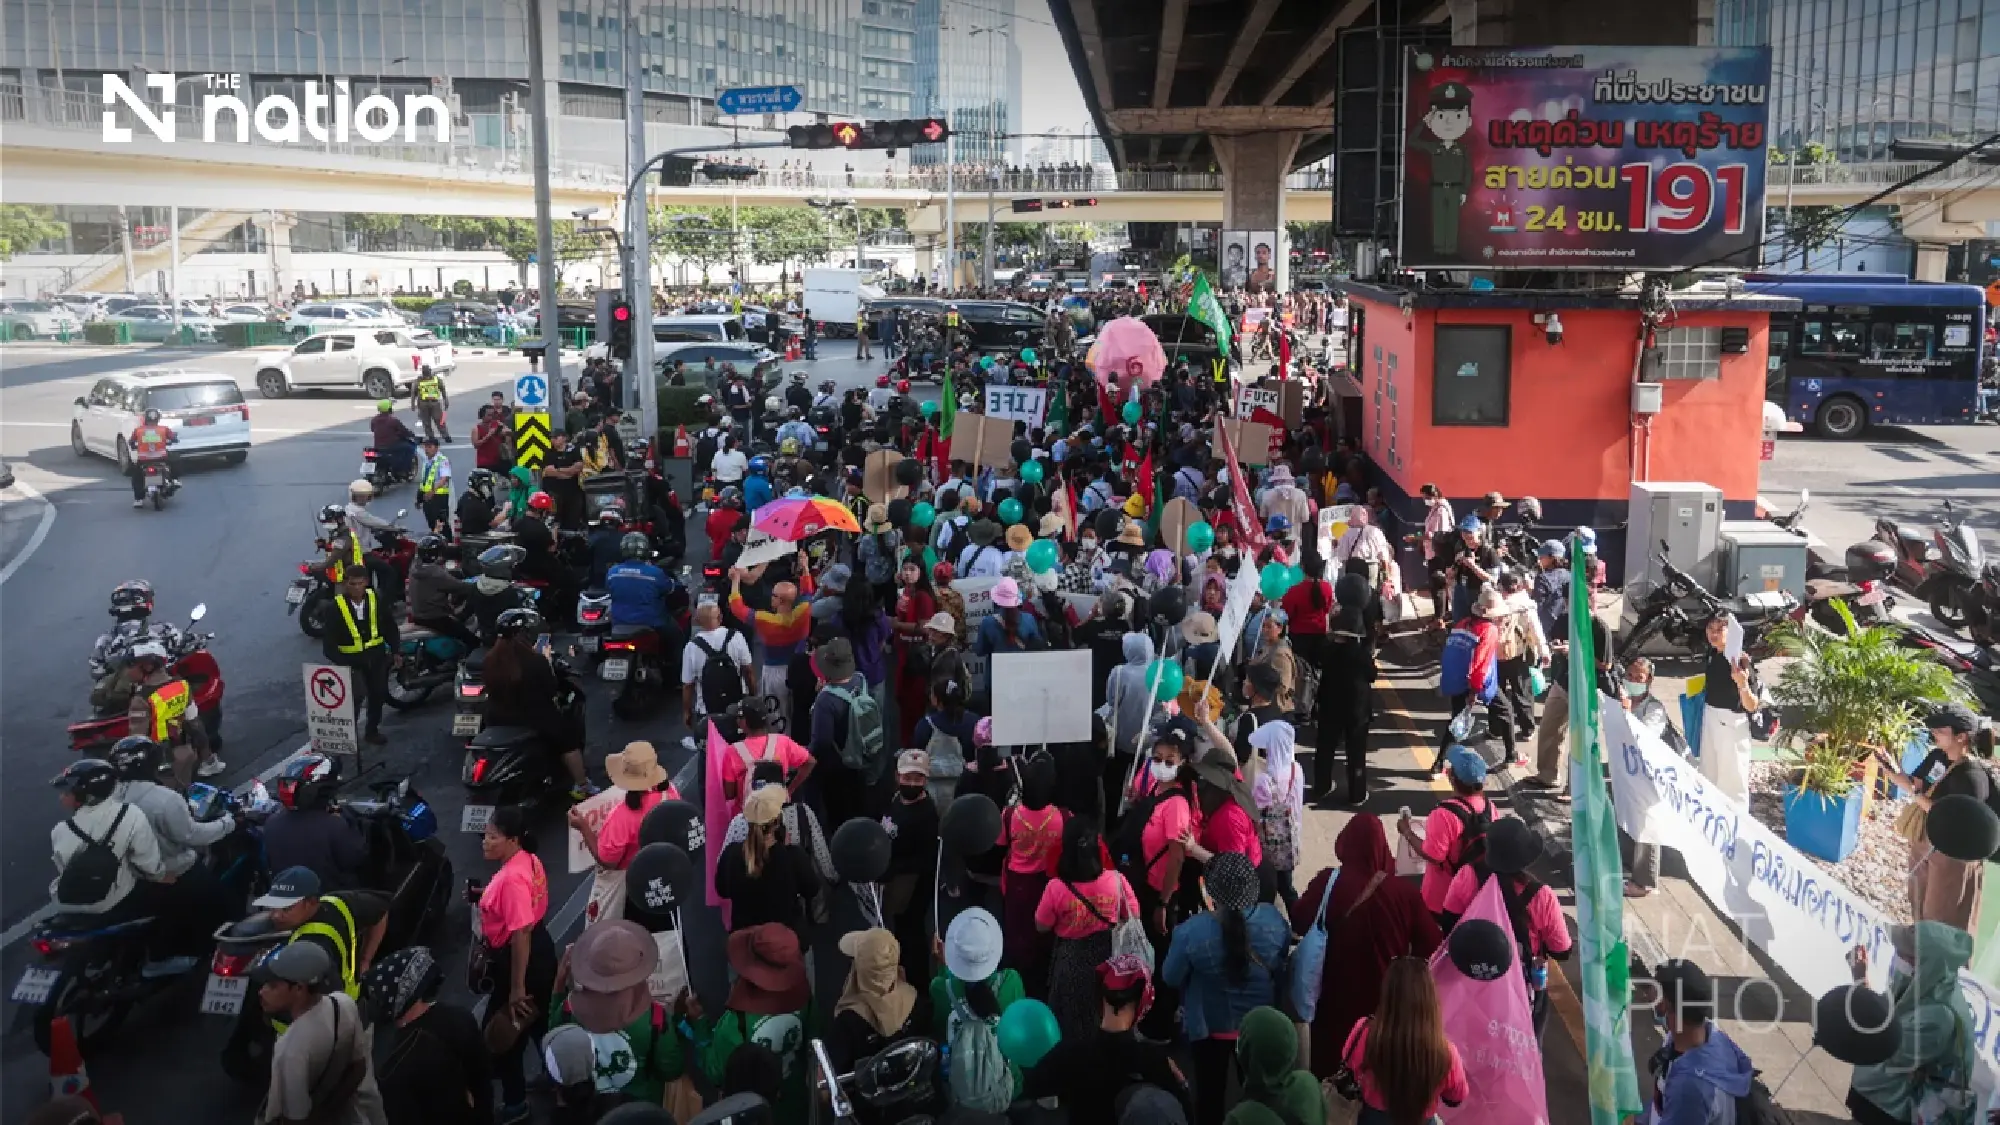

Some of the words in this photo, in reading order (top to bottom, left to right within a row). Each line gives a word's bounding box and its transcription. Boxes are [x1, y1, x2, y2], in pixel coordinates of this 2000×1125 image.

[1594, 69, 1766, 104] ที่พึ่งประชาชน
[1489, 109, 1624, 157] เหตุด่วน
[1635, 111, 1763, 159] เหตุร้าย
[1484, 155, 1616, 189] สายด่วน
[1621, 162, 1748, 235] 191
[1525, 205, 1567, 232] 24
[1577, 210, 1623, 232] ชม.
[1245, 390, 1278, 404] FUCK
